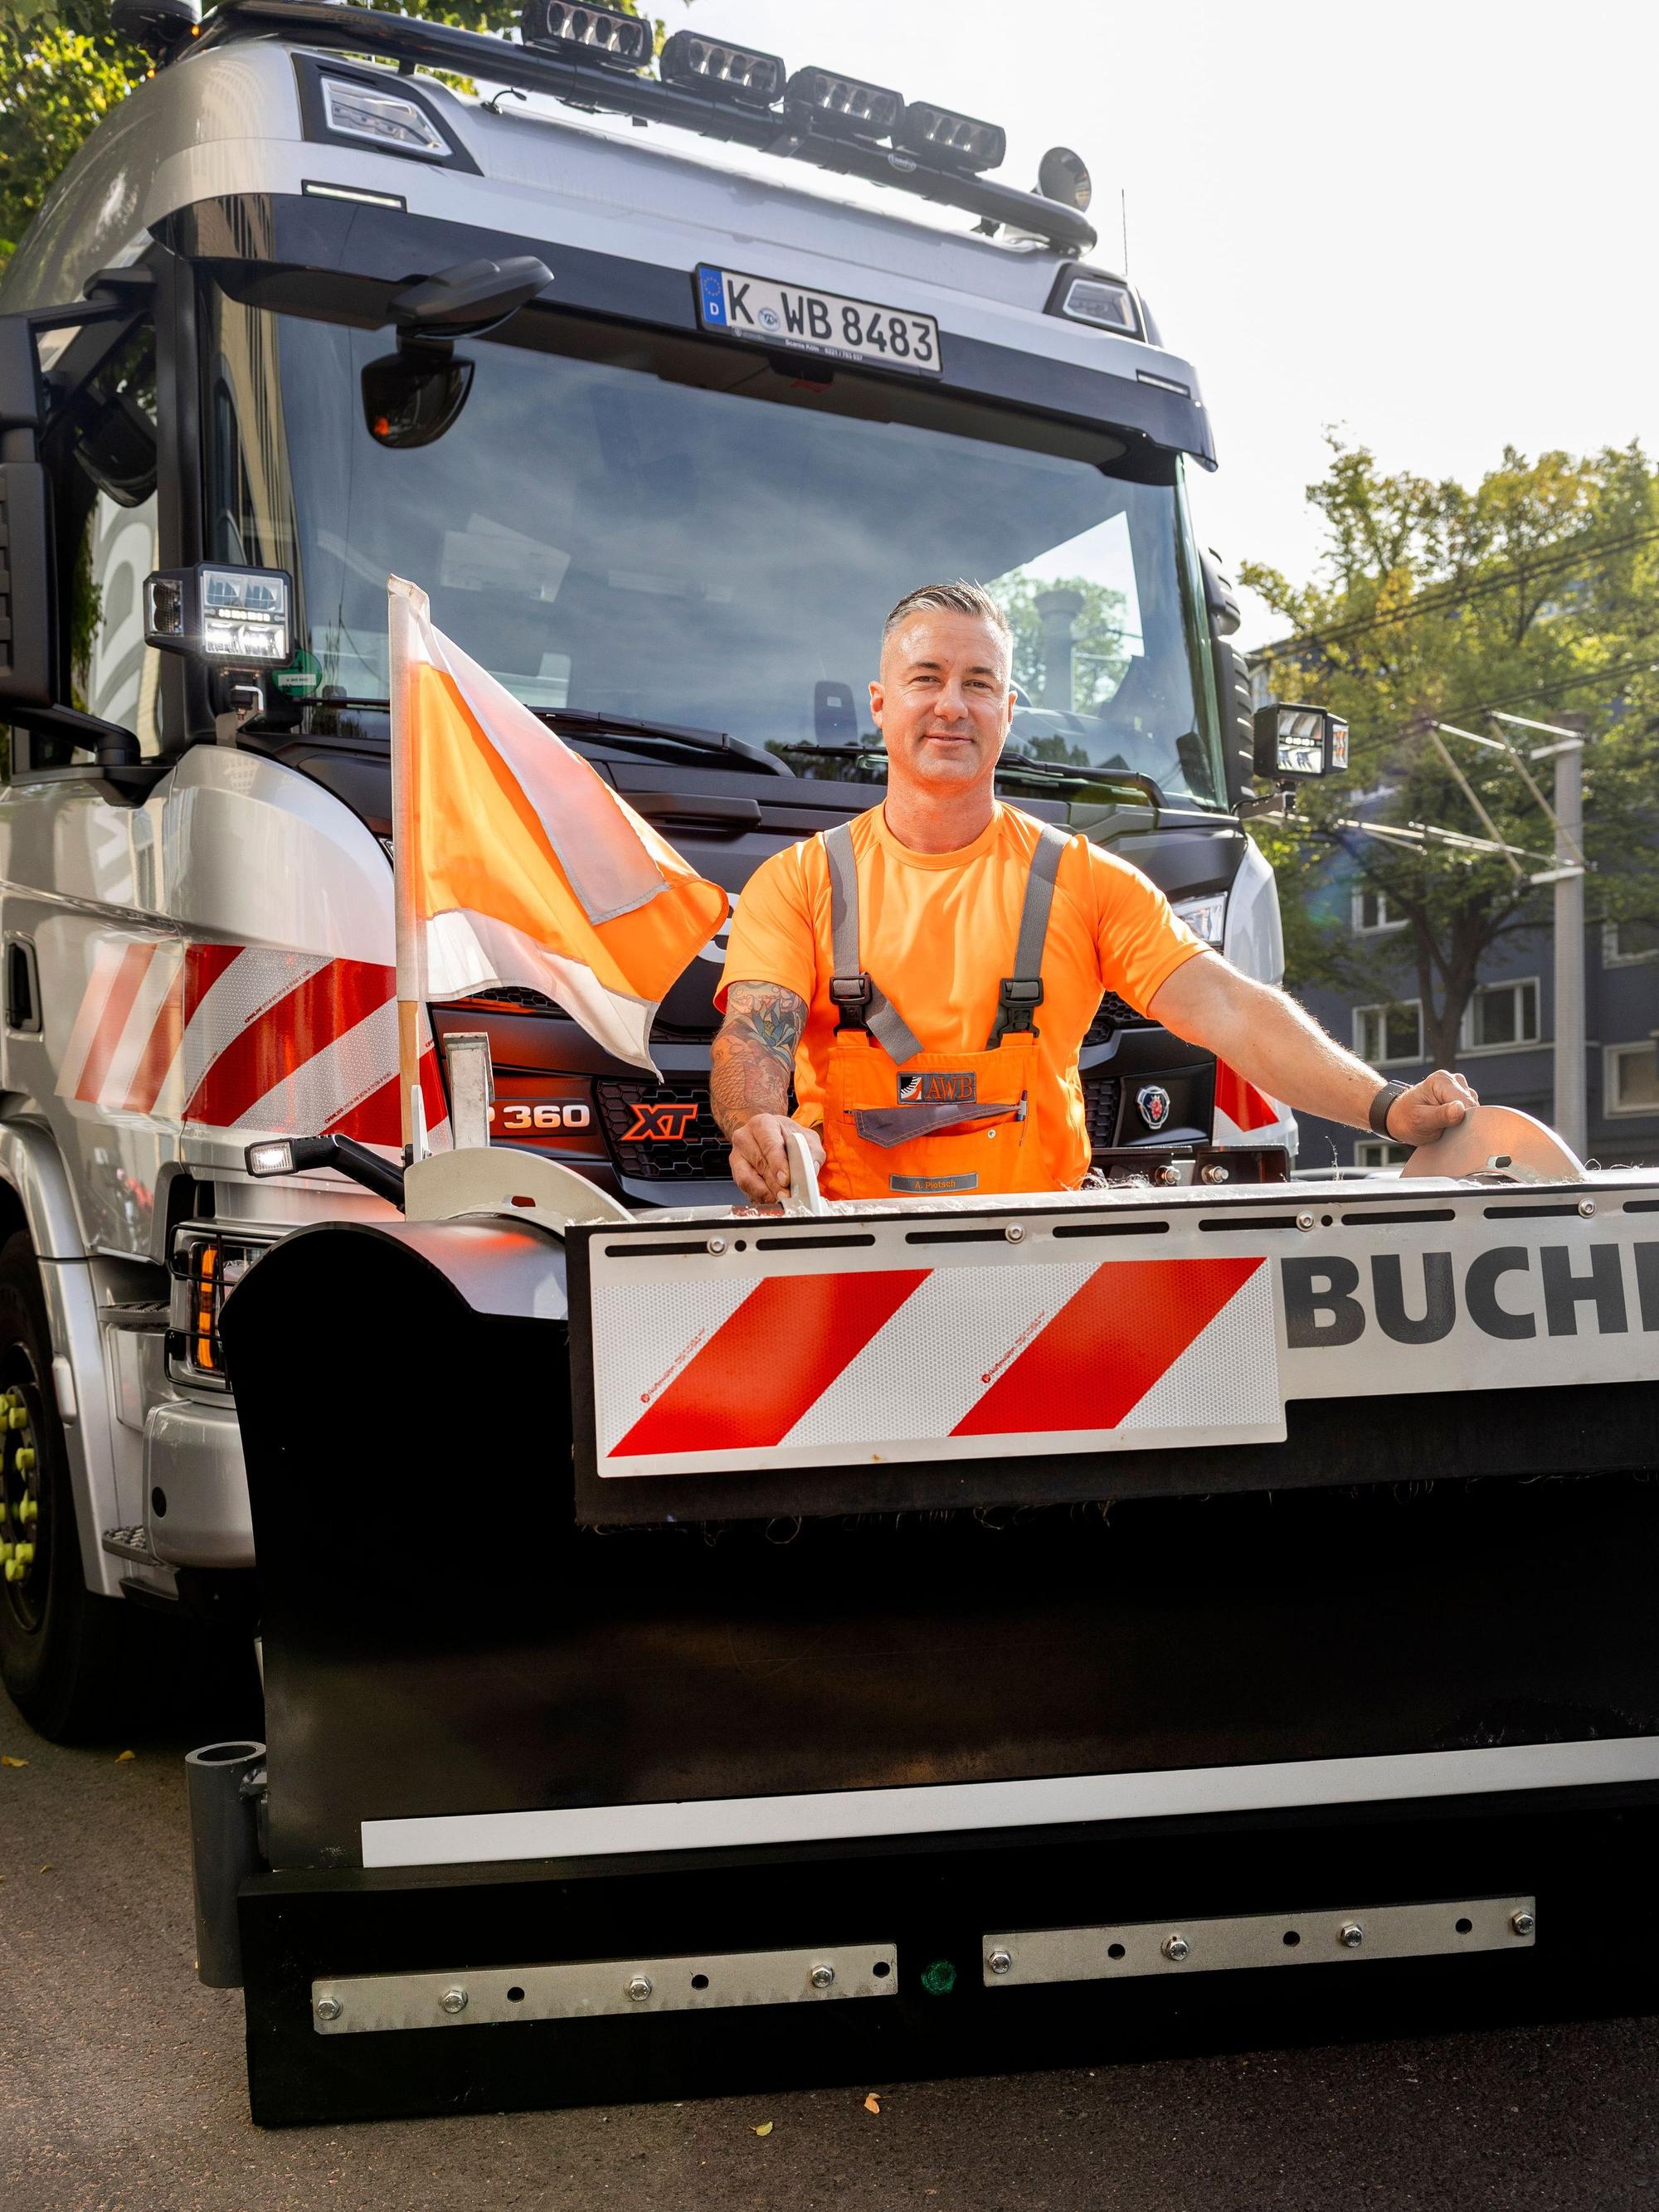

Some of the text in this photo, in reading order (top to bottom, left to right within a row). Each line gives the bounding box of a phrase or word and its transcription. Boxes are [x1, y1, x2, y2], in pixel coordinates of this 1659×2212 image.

[709, 302, 719, 315] D
[727, 280, 932, 362] K WB 8483
[925, 1075, 973, 1101] AWB
[503, 1104, 590, 1130] 360
[620, 1104, 698, 1141] XT
